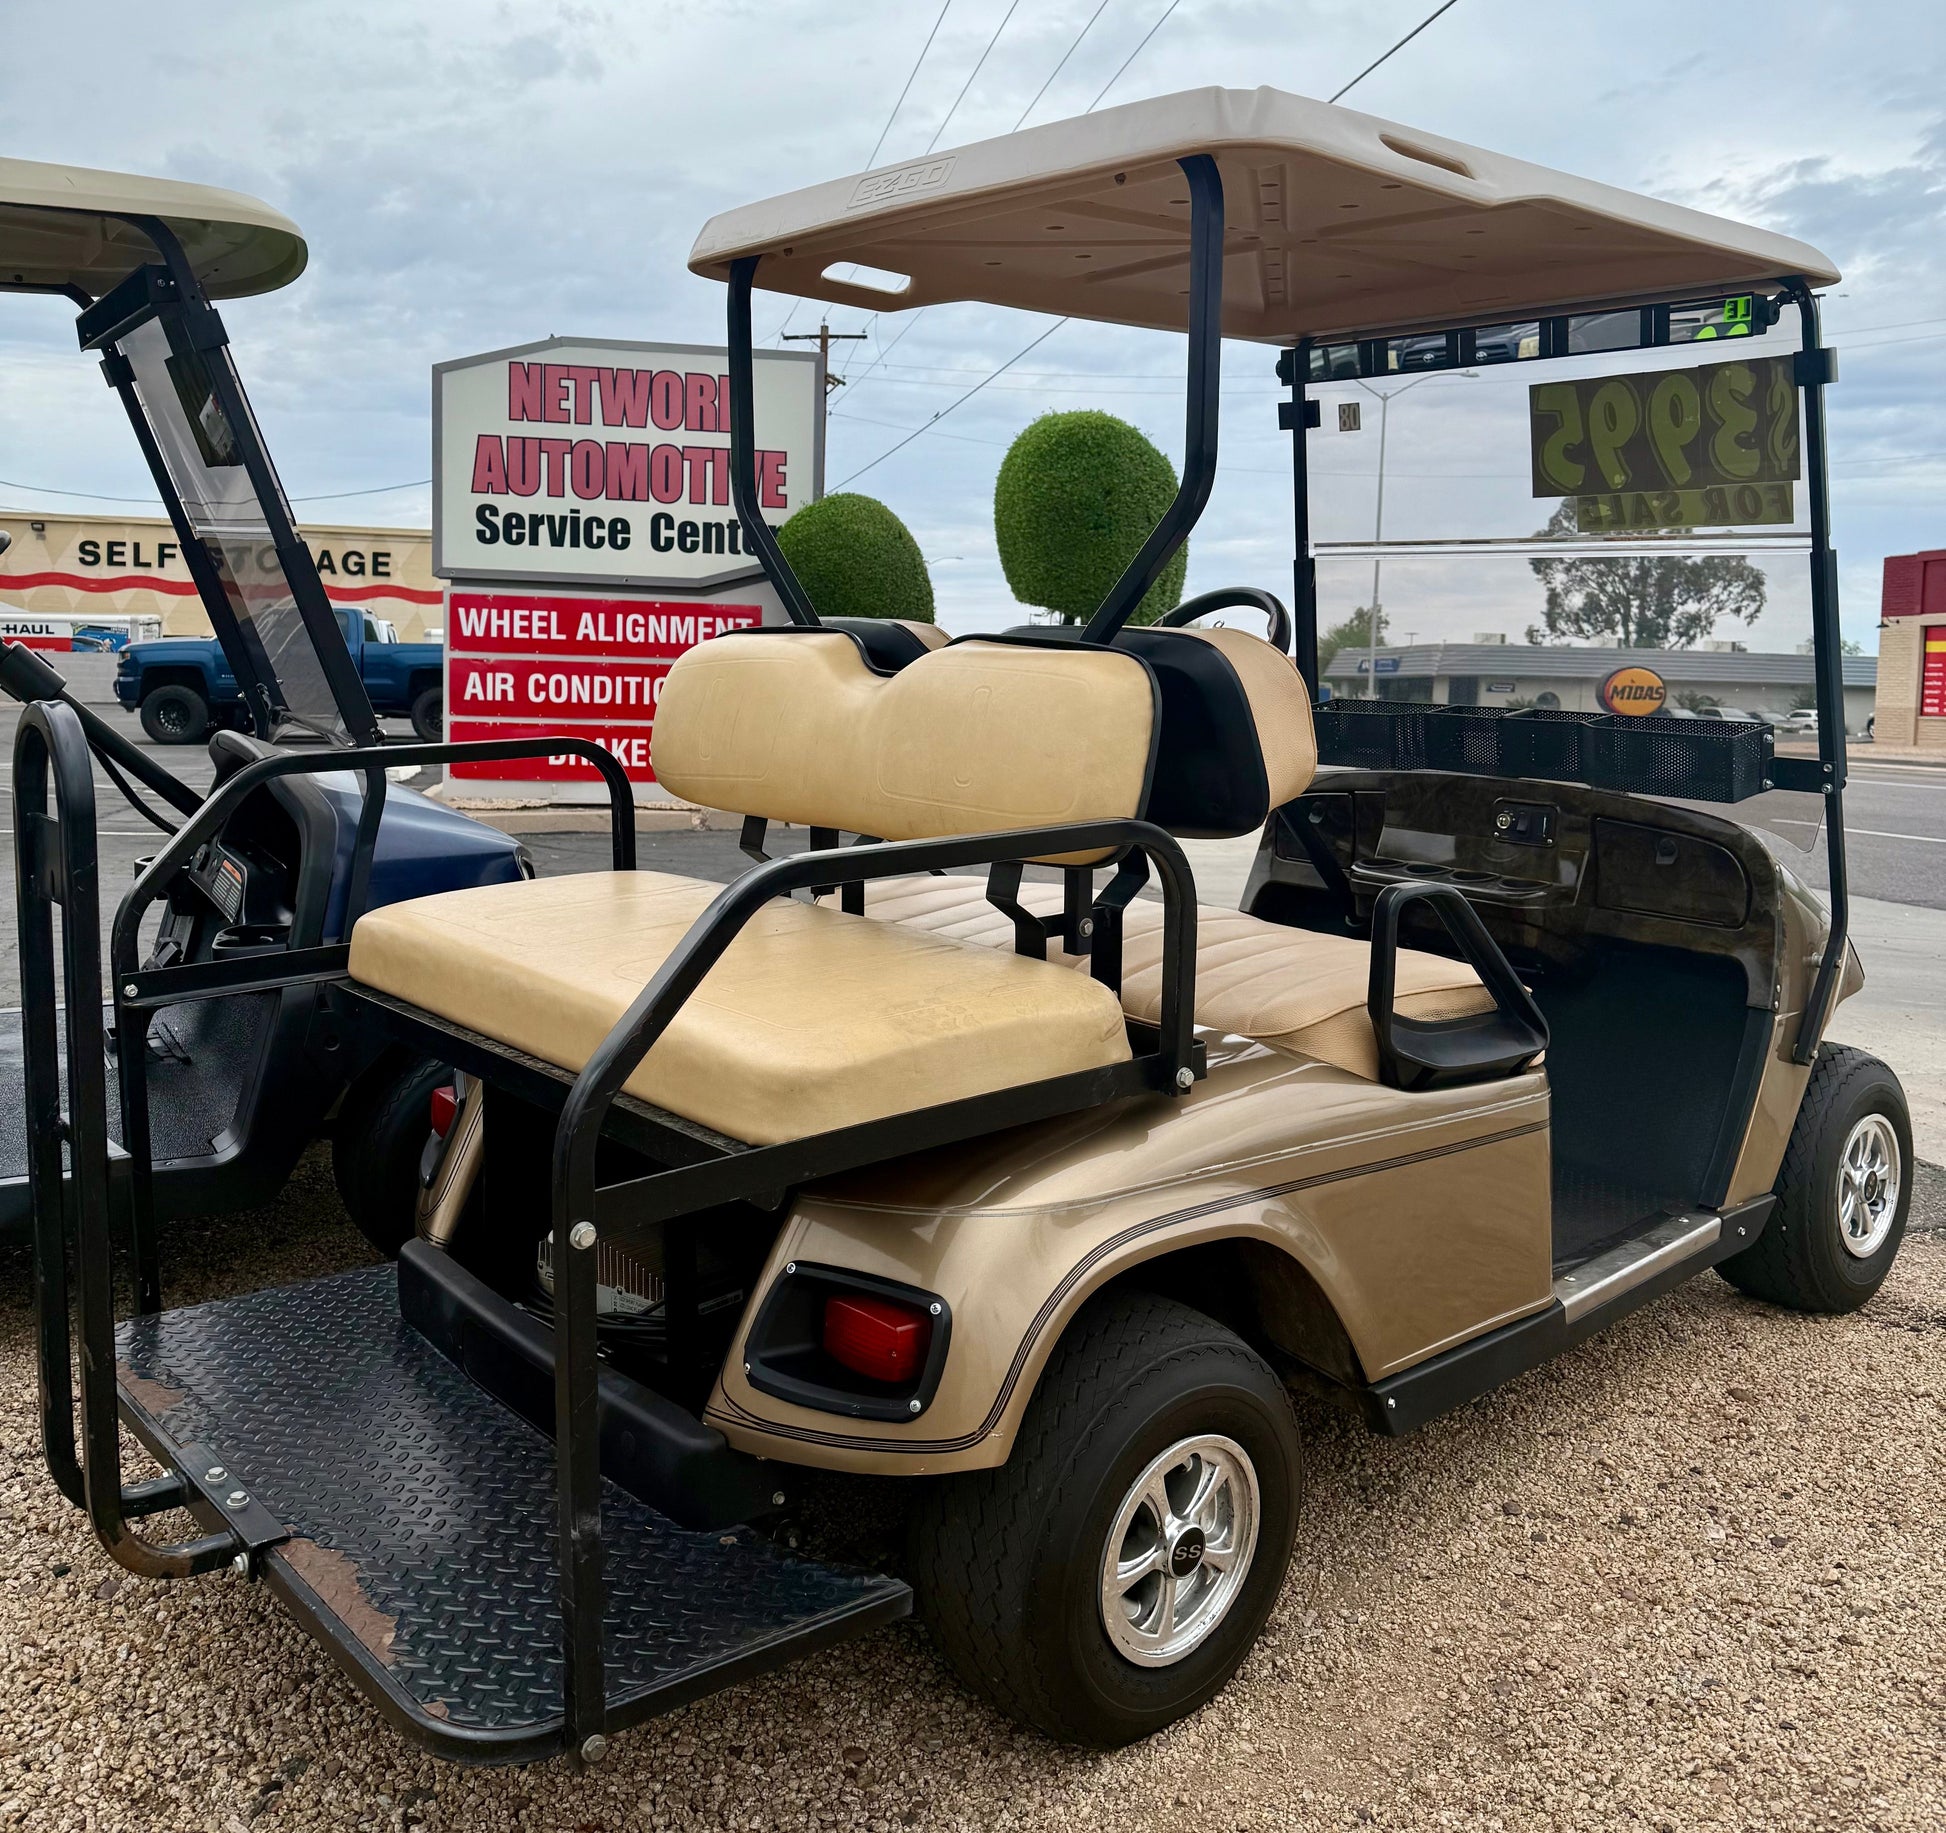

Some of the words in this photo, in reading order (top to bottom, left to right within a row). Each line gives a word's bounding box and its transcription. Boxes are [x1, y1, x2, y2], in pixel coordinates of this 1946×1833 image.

[475, 503, 631, 551] Service
[650, 511, 782, 556] Cent
[78, 540, 177, 568] SELF
[206, 544, 391, 577] TOAGE
[458, 608, 566, 640] WHEEL
[464, 672, 515, 701] AIR
[1611, 684, 1664, 700] MIDAS
[1174, 1544, 1202, 1560] SS
